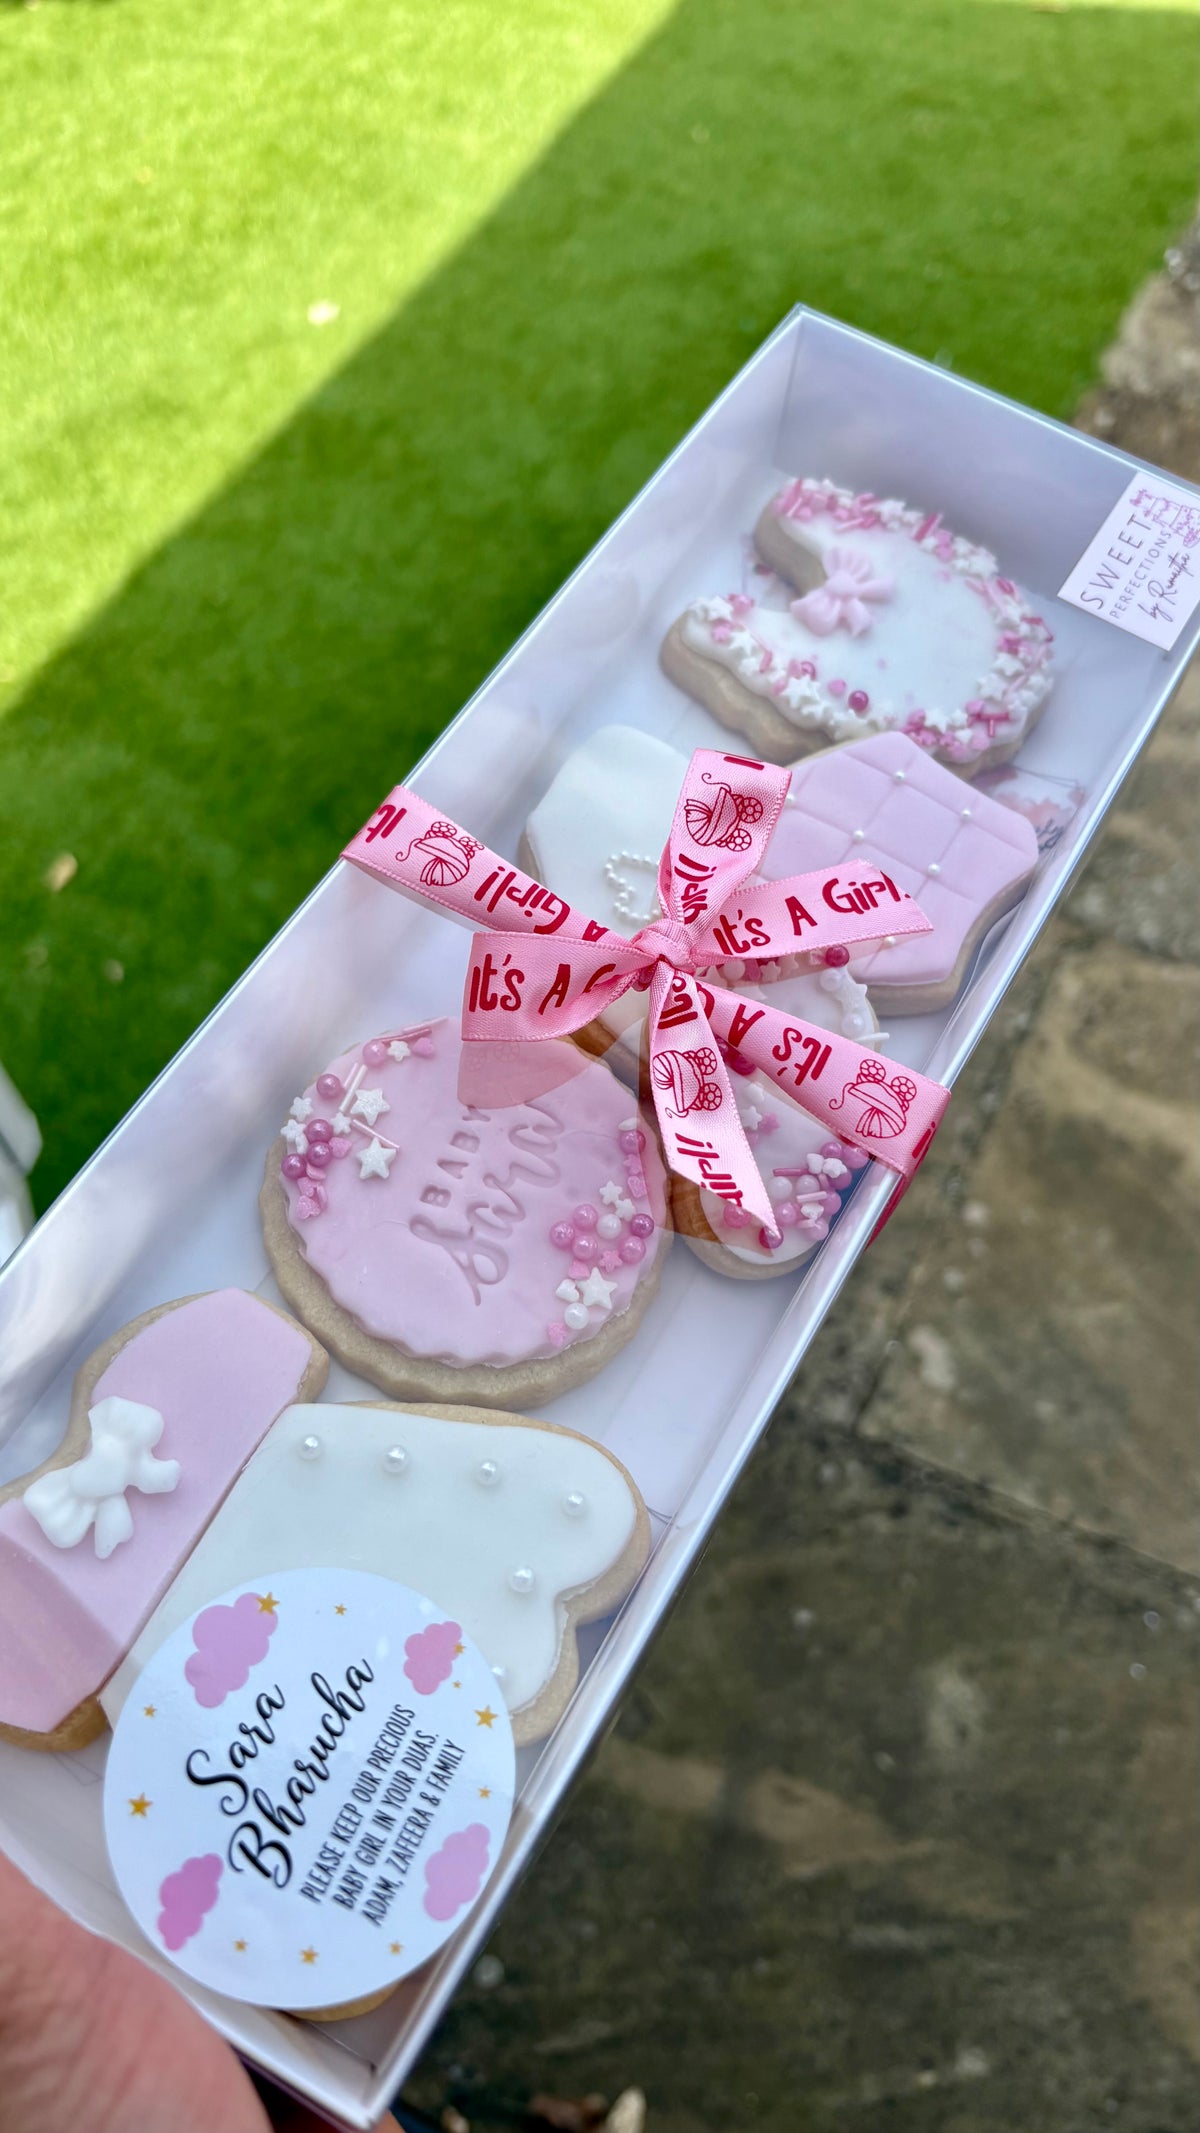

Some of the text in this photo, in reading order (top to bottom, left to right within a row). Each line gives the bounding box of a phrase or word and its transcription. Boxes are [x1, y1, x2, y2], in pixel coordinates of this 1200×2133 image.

[1080, 513, 1152, 609] SWEET
[1109, 530, 1172, 619] PERFECTIONS
[1137, 602, 1173, 622] by
[473, 866, 571, 936] Girl!
[712, 909, 771, 956] It's
[784, 895, 818, 936] A
[468, 953, 525, 1013] It's
[537, 963, 571, 1016] A
[722, 1003, 832, 1087] It's A
[185, 1683, 286, 1817] Sara
[227, 1658, 375, 1890] Bharucha
[299, 1703, 416, 1903] PLEASE KEEP OUR PRECIOUS
[332, 1729, 437, 1910] BABY GIRL IN YOUR DUAS.
[361, 1738, 466, 1927] ADAM, ZAFEERA & FAMILY
